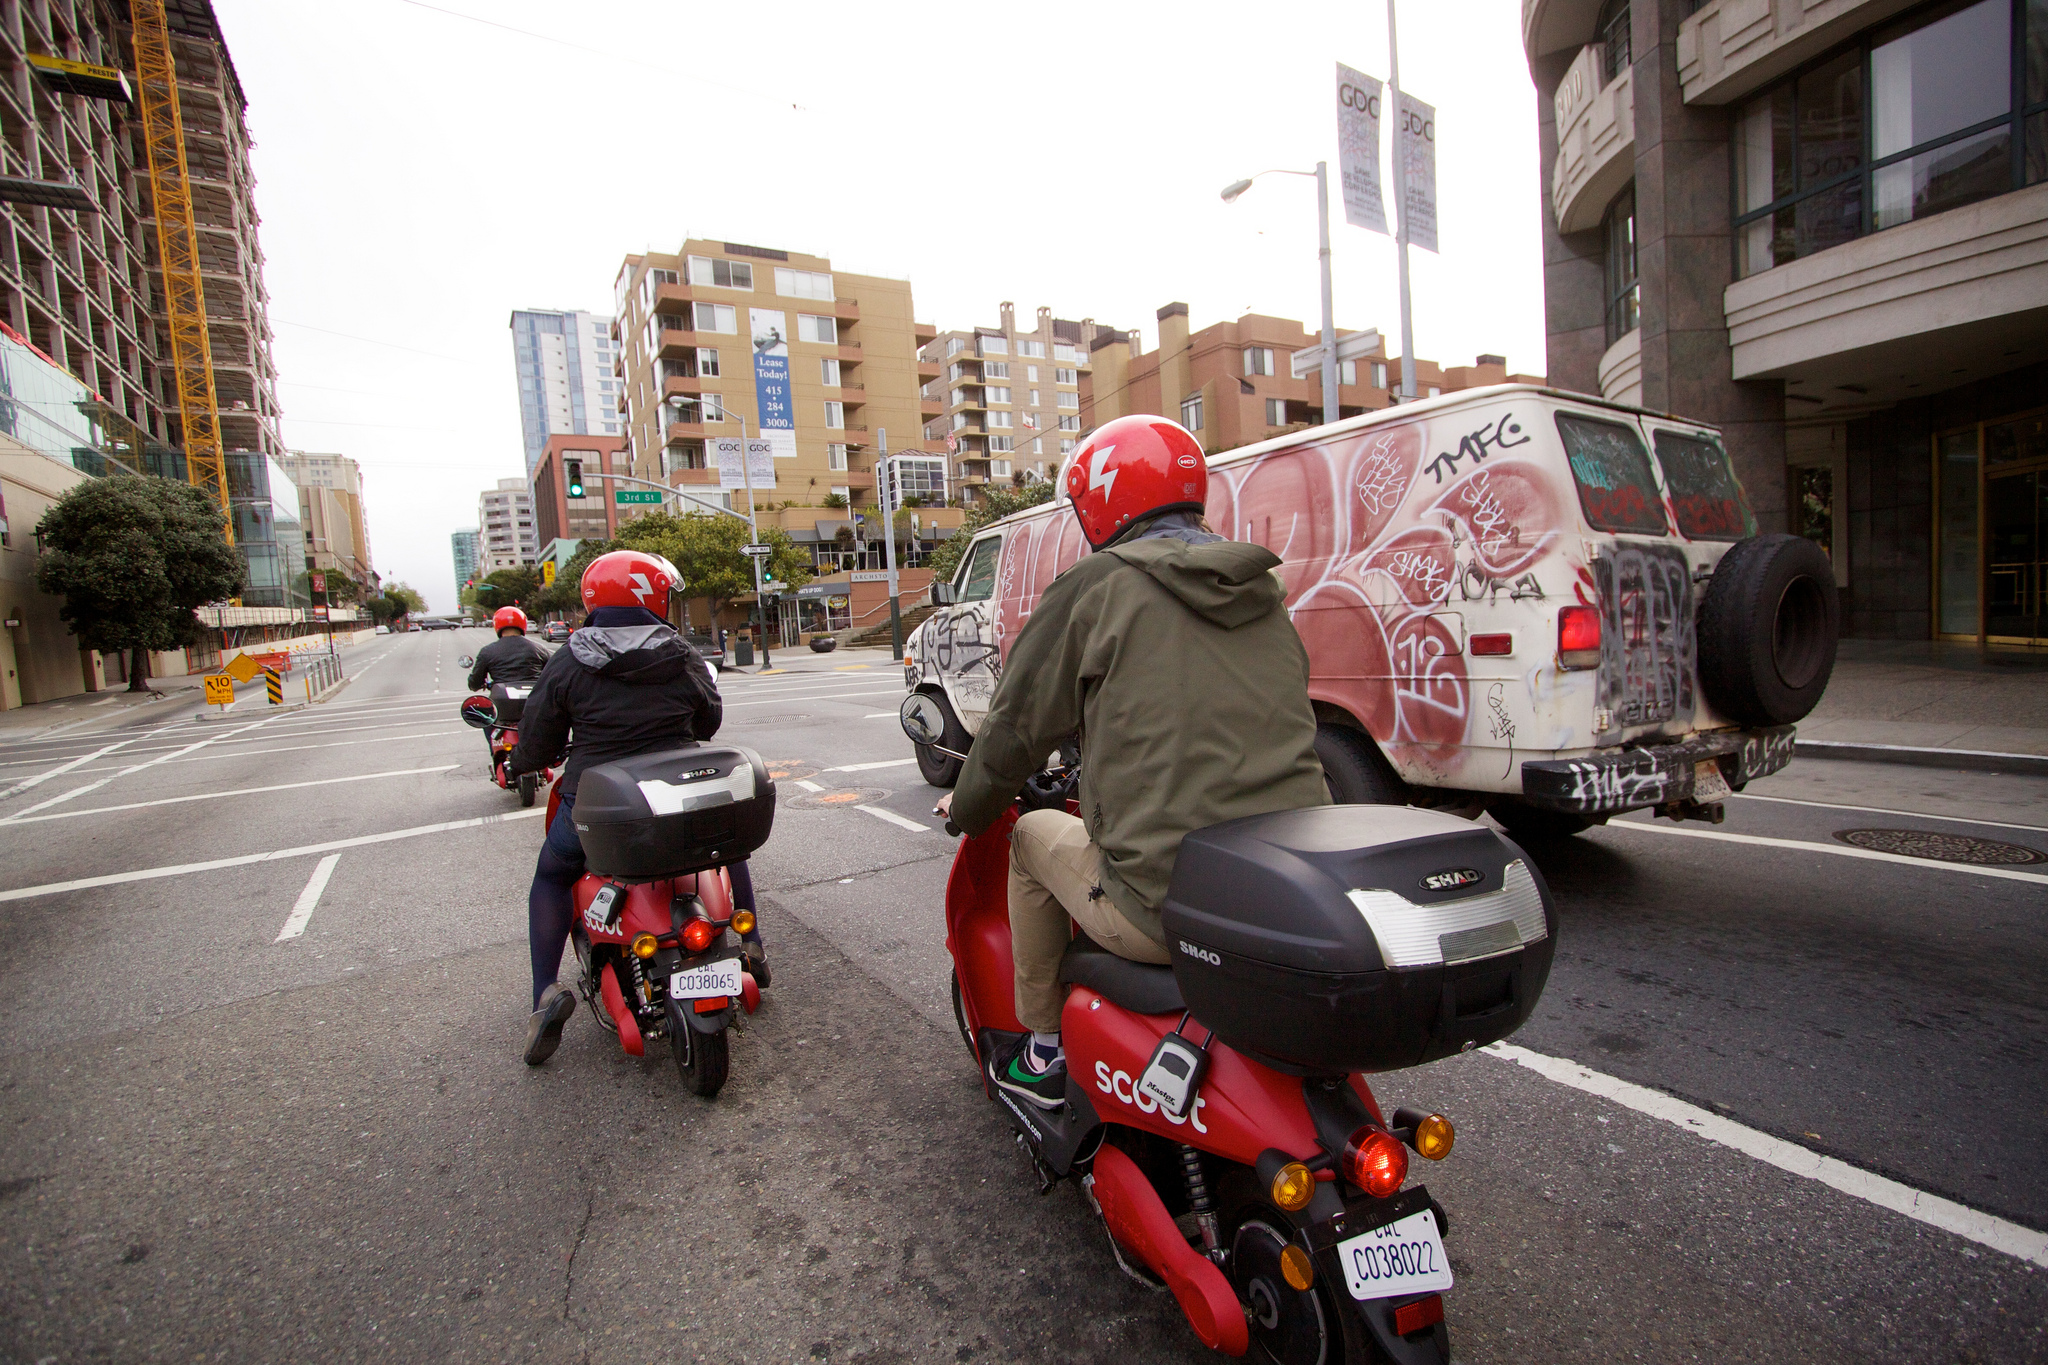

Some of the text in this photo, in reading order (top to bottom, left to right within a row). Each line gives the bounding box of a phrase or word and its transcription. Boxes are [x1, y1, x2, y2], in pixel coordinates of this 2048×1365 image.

[1340, 83, 1379, 120] GDC
[760, 356, 784, 367] Lease
[757, 368, 788, 381] Today!
[765, 385, 782, 395] 415
[767, 402, 784, 411] 284
[766, 418, 788, 427] 3000
[718, 443, 740, 452] GDC
[749, 444, 771, 452] GDC
[624, 493, 640, 501] 3rd
[215, 677, 230, 687] 10
[682, 768, 716, 779] SHAD
[1426, 869, 1479, 890] SHAD
[1180, 940, 1222, 966] SH40
[679, 973, 735, 991] C038065
[1147, 1081, 1176, 1102] Master
[1353, 1240, 1440, 1281] C038022
